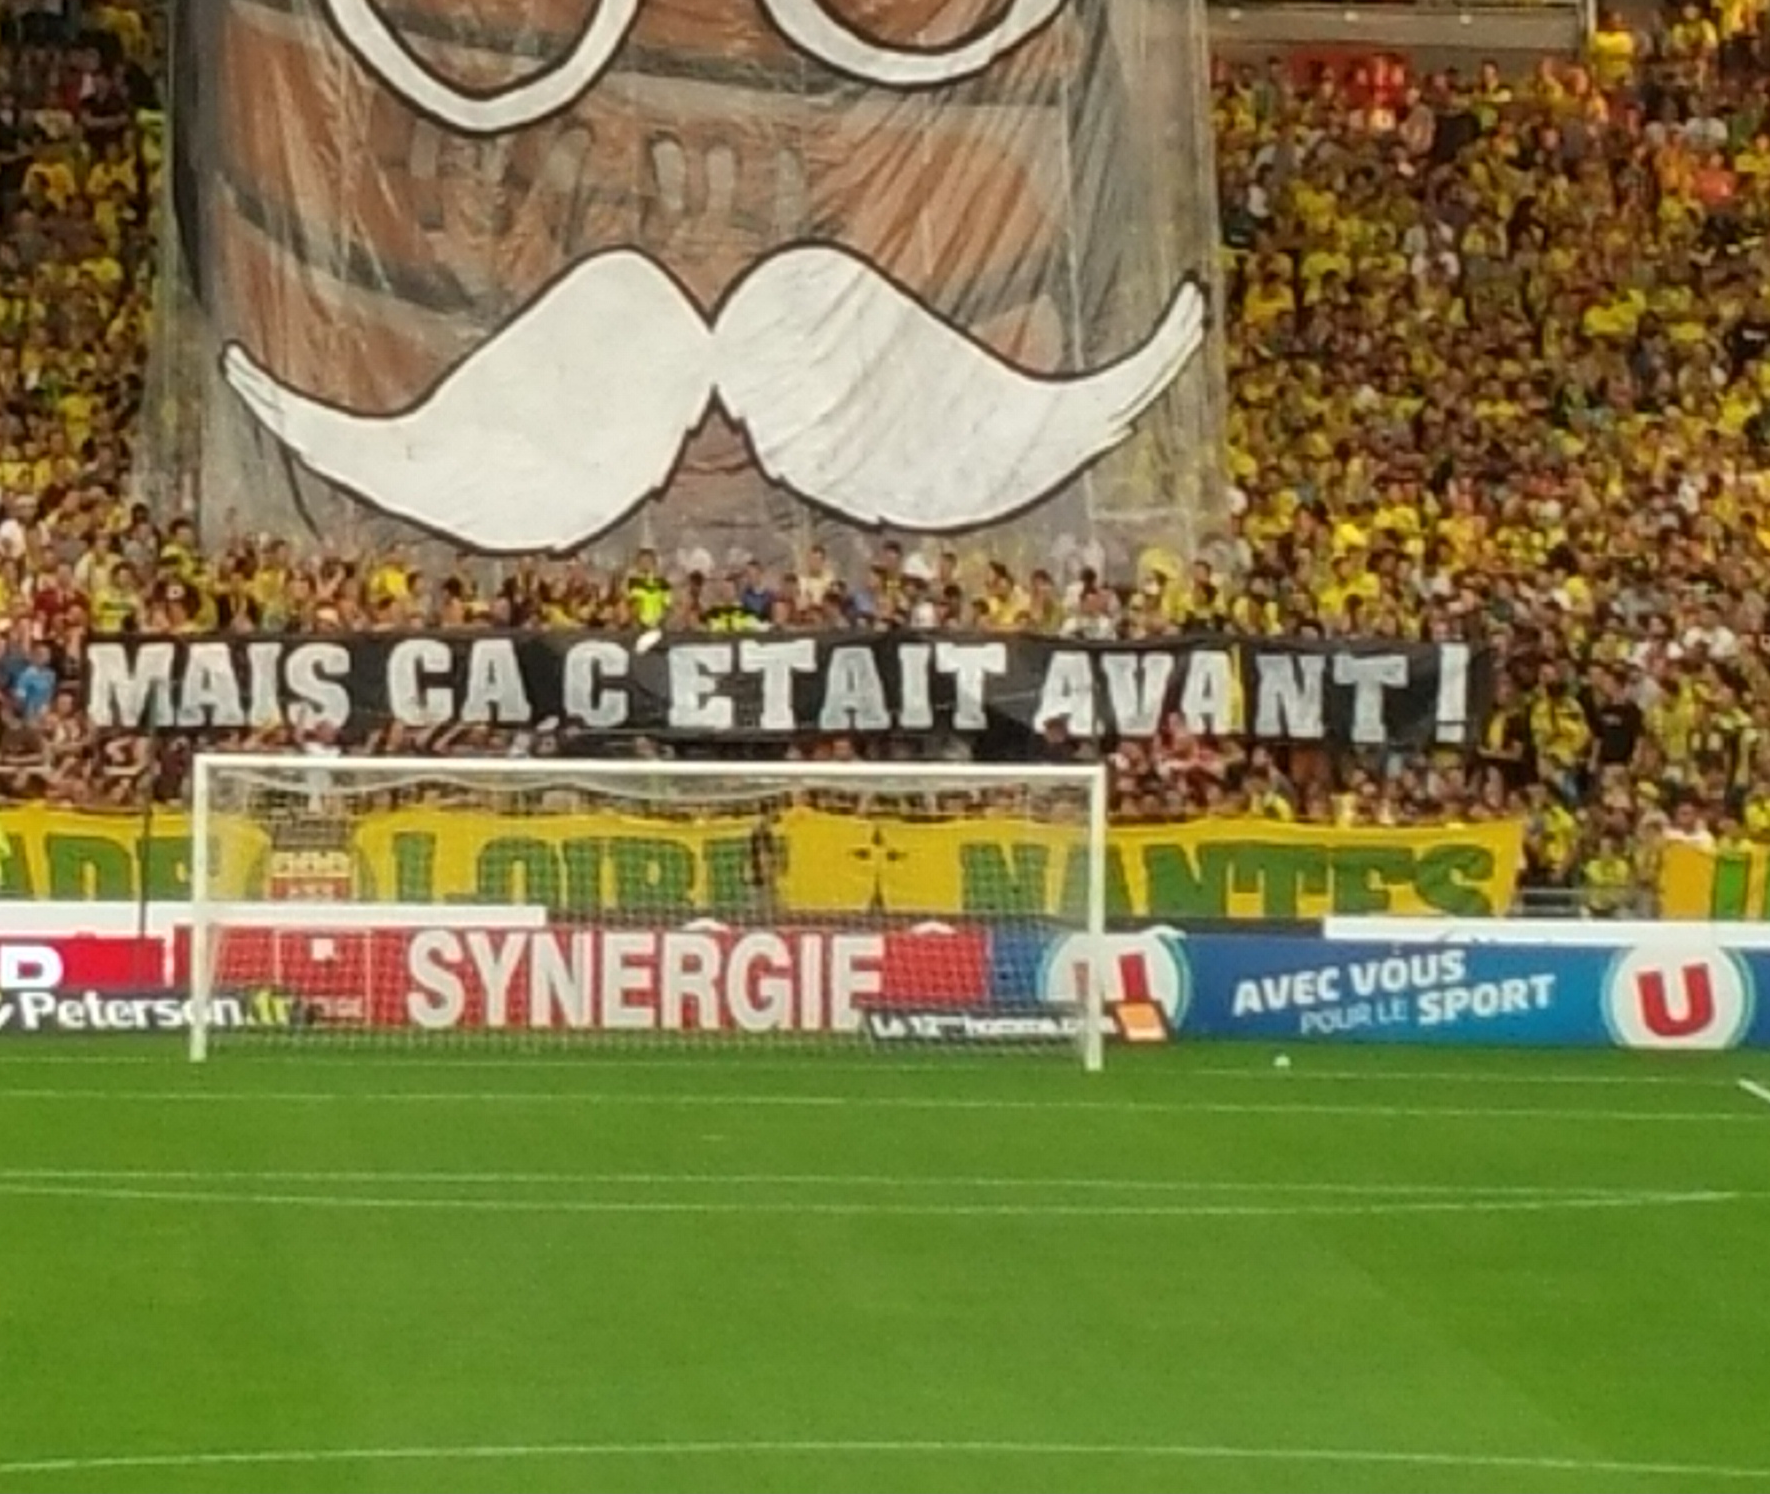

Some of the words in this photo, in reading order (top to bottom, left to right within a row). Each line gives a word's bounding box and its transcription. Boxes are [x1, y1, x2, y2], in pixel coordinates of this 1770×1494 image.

[87, 641, 351, 729] MAIS
[1033, 649, 1409, 743] AVANT
[959, 839, 1496, 917] NANTES
[408, 929, 886, 1031] SYNERGIE
[1232, 966, 1341, 1017] AVEC
[1348, 949, 1466, 997] VOUS
[1300, 1004, 1372, 1035] POUR
[1378, 997, 1408, 1024] LE
[1416, 973, 1557, 1025] SPORT
[1635, 962, 1716, 1038] U
